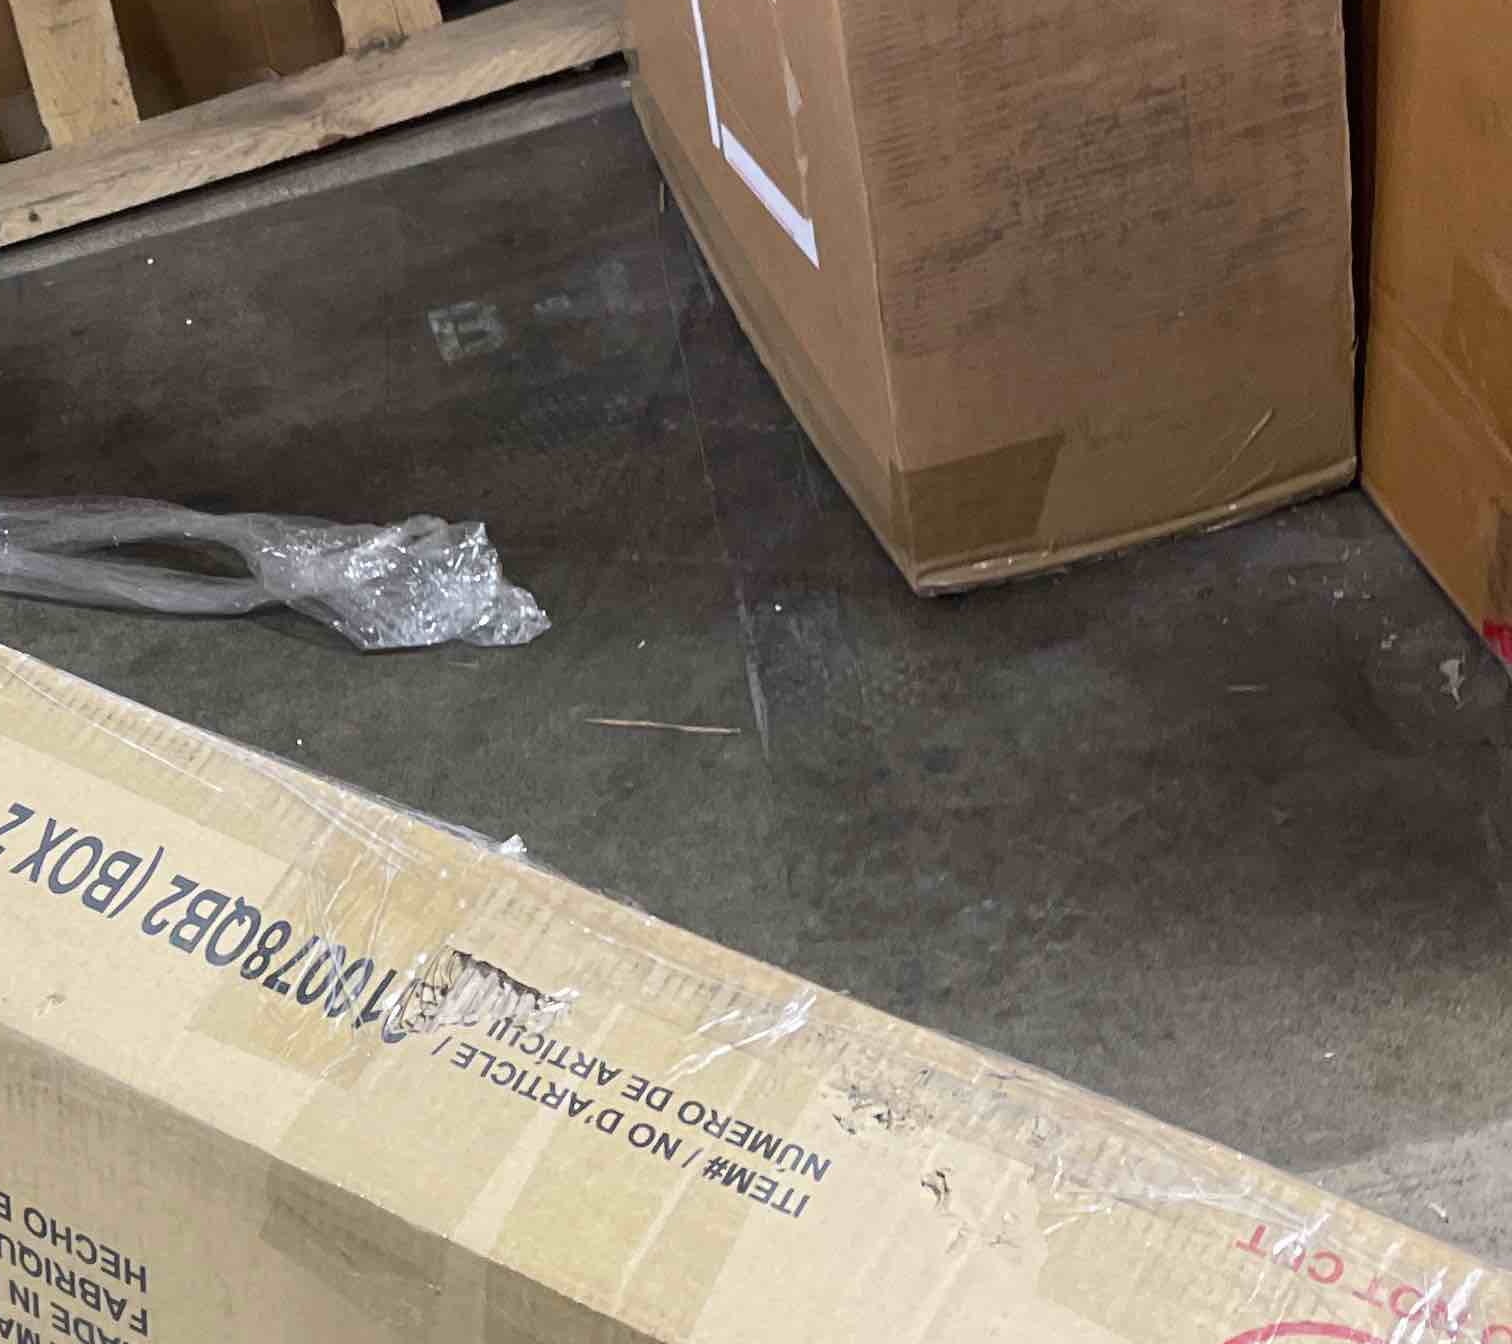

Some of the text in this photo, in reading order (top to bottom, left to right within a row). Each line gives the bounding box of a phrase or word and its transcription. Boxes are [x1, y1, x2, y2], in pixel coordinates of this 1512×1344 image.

[11, 818, 165, 919] (BOX
[450, 1042, 625, 1135] D'ARTICLE
[464, 1018, 832, 1182] NÚMERO DE ARTÍCU
[628, 1123, 688, 1161] NO
[702, 1155, 810, 1218] ITEM#
[23, 1207, 147, 1293] HECHO
[9, 1288, 41, 1319] IN
